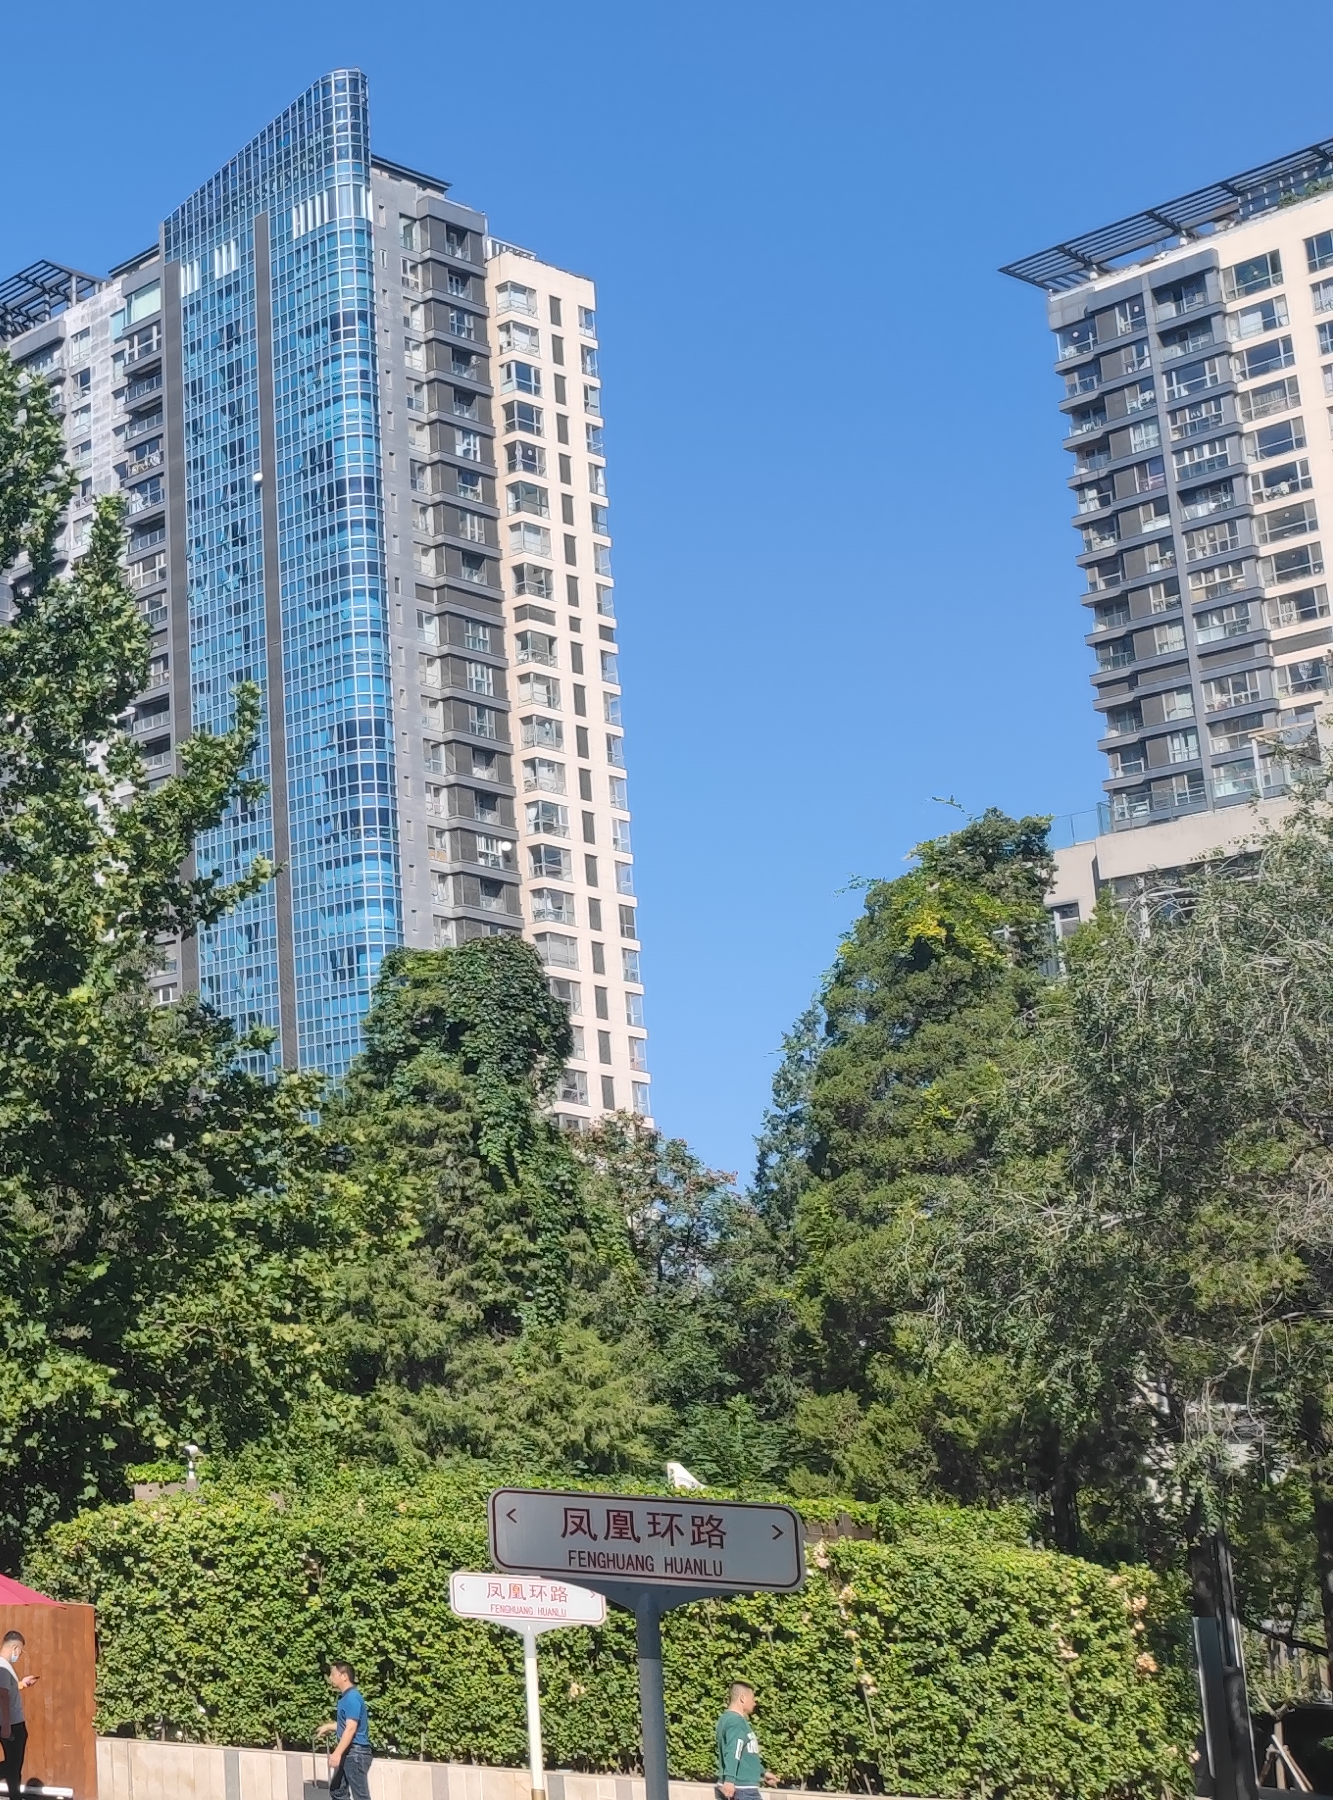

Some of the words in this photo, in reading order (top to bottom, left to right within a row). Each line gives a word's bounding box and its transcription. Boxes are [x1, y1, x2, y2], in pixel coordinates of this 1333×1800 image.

[560, 1506, 727, 1550] 凤凰环路
[567, 1549, 655, 1573] FENGHUANG
[664, 1556, 723, 1578] HUANLU
[486, 1581, 569, 1604] 凤凰环路
[490, 1603, 535, 1616] FENGHUANG
[537, 1606, 568, 1618] HUANLU
